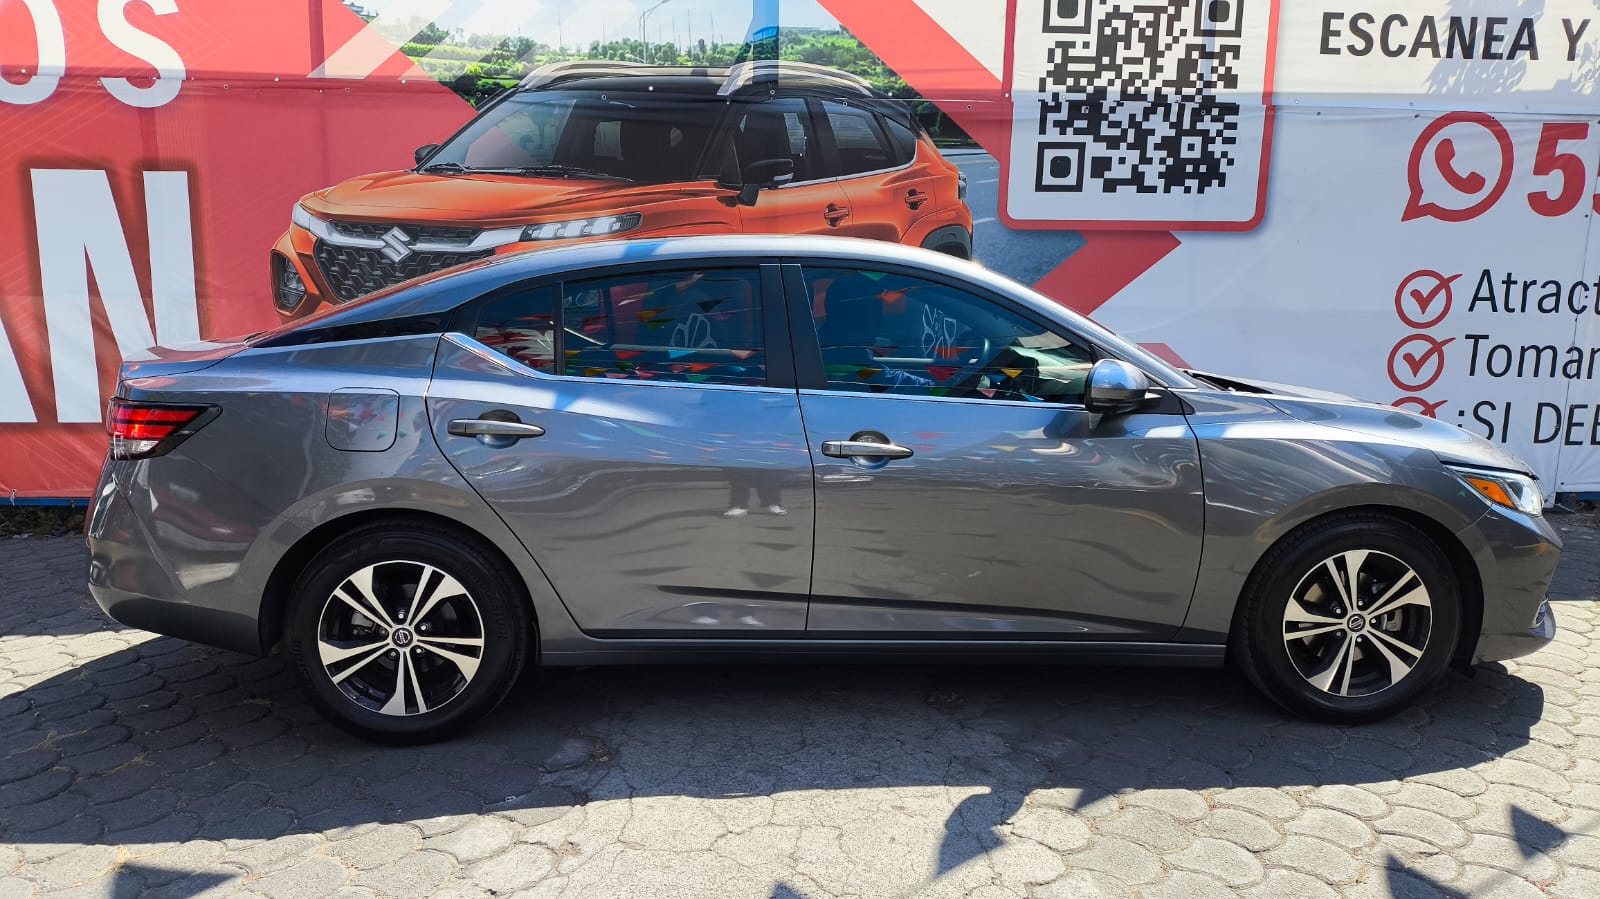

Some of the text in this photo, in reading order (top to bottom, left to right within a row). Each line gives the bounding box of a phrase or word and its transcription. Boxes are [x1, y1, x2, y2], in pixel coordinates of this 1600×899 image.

[1320, 12, 1591, 61] ESCANEA Y
[1527, 122, 1600, 217] 5
[0, 168, 200, 423] N
